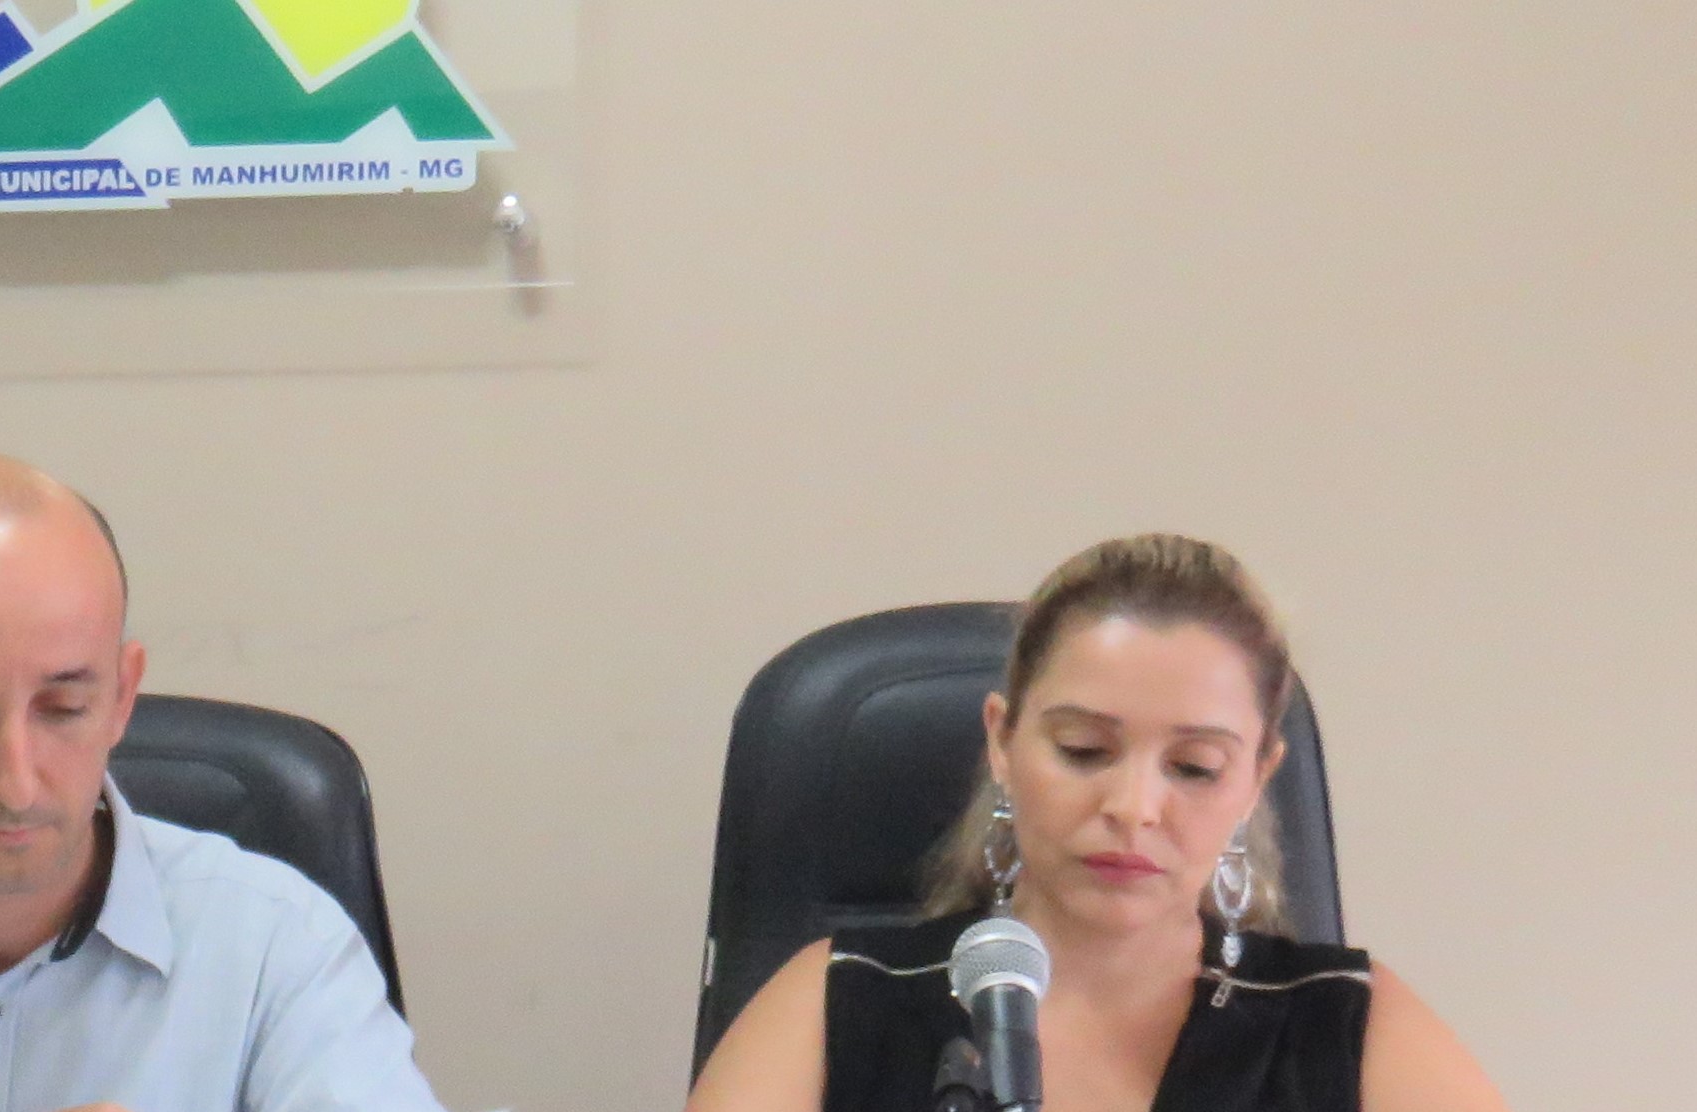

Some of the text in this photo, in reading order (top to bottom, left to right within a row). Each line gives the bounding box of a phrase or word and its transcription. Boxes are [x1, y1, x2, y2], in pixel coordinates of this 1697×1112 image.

[145, 168, 180, 188] DE
[192, 161, 390, 187] MANHUMIRIM
[419, 158, 463, 178] MG
